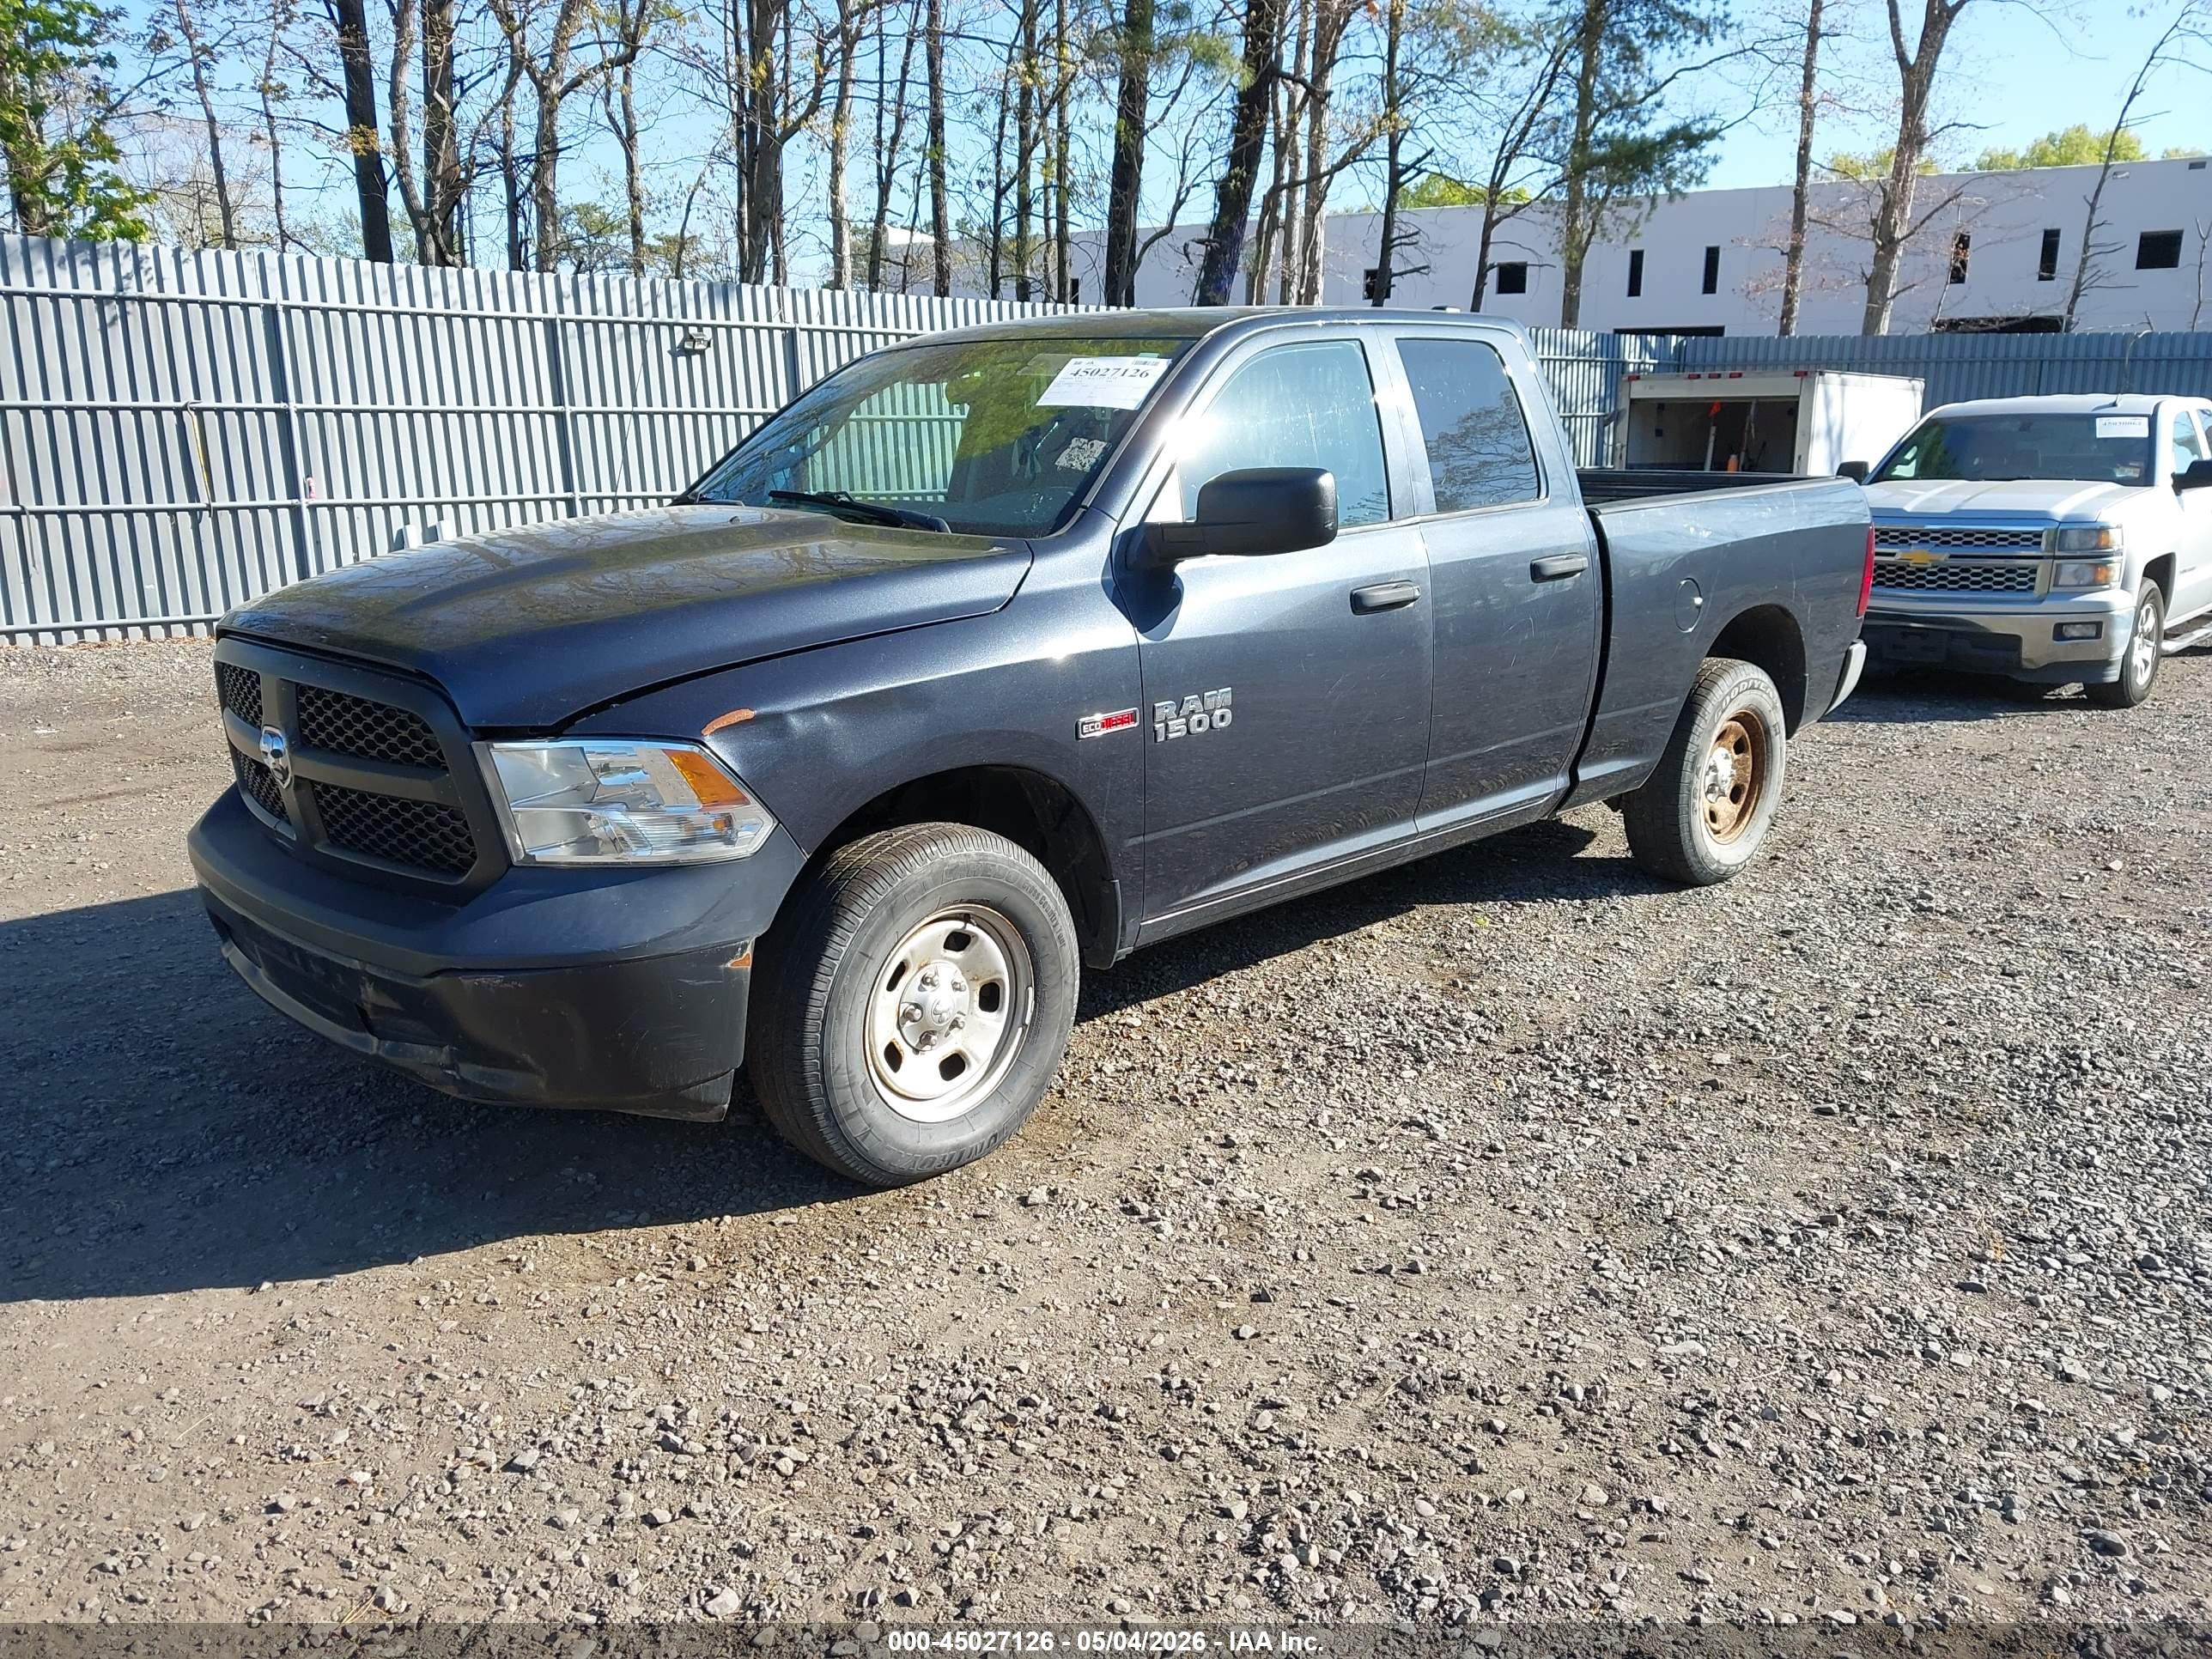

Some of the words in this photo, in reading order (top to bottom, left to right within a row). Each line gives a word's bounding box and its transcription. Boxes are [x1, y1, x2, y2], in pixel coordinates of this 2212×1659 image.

[1070, 367, 1151, 379] 45027126
[1153, 686, 1233, 723] RAM
[1153, 708, 1233, 744] 1500
